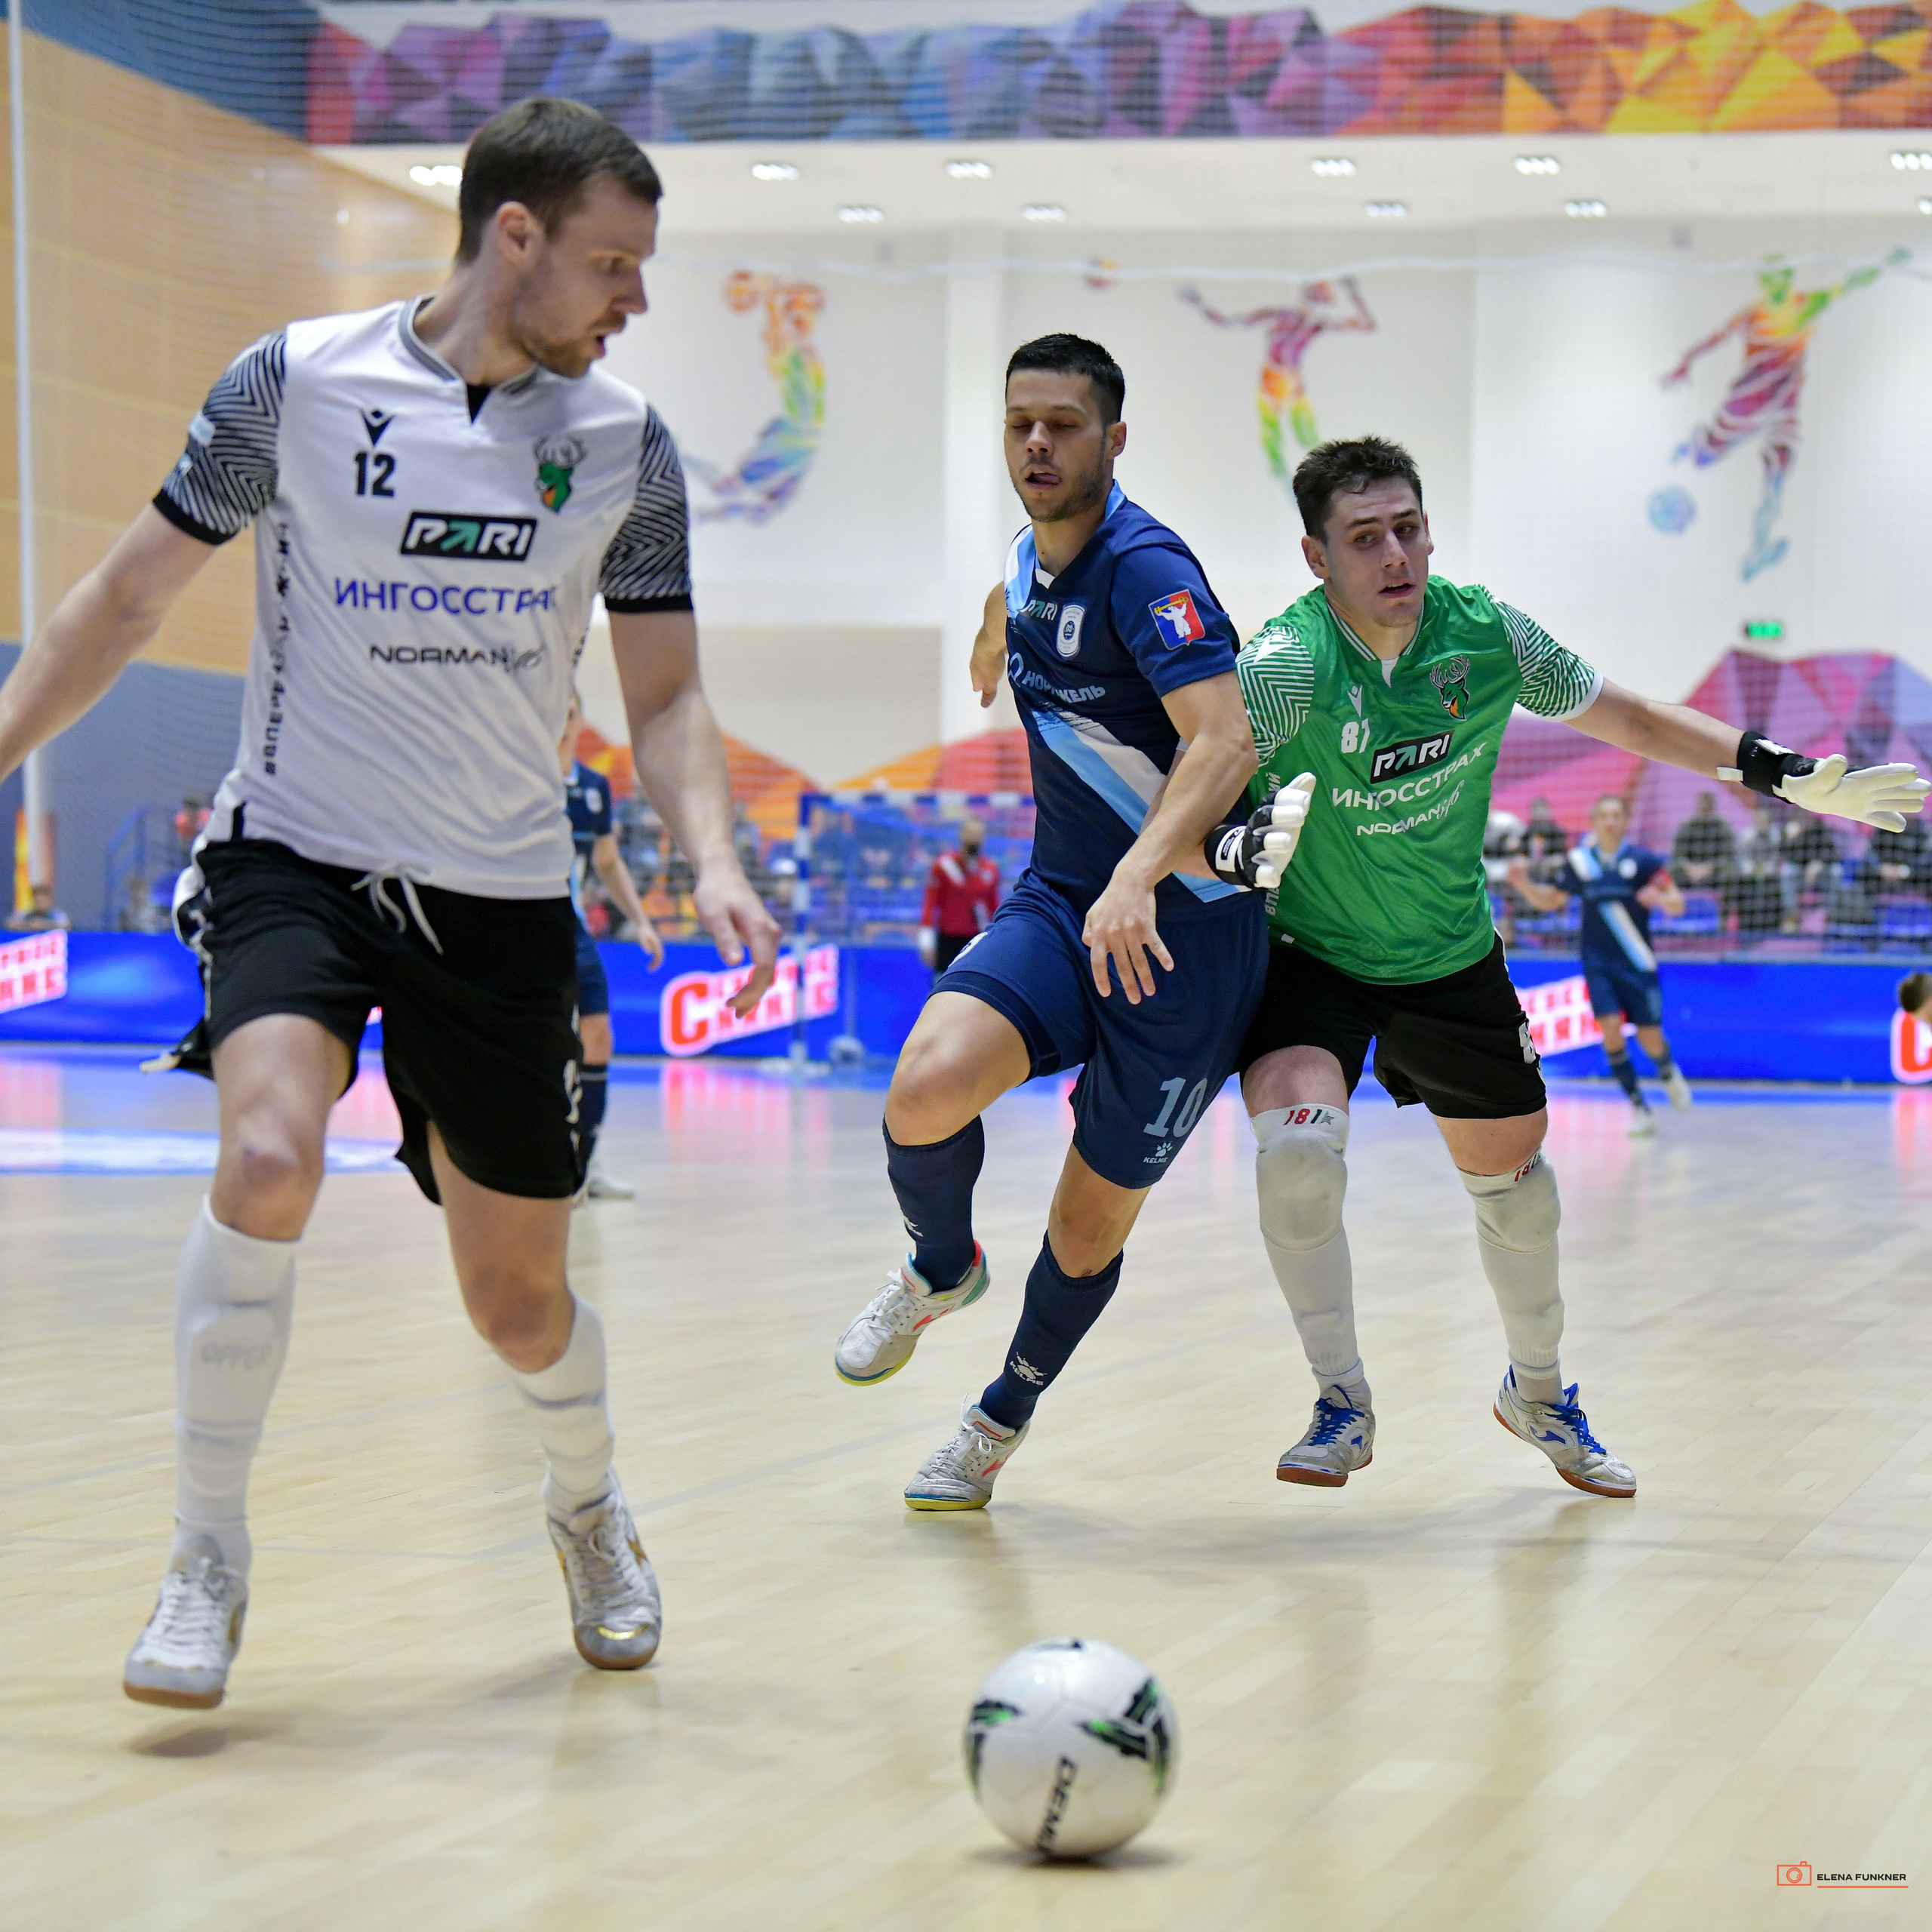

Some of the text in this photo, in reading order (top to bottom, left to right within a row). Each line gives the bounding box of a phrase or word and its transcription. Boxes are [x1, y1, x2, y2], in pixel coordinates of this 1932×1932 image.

[354, 451, 396, 498] 12
[405, 518, 533, 556] PARI
[1374, 734, 1450, 777] PARI
[1143, 1076, 1208, 1138] 10
